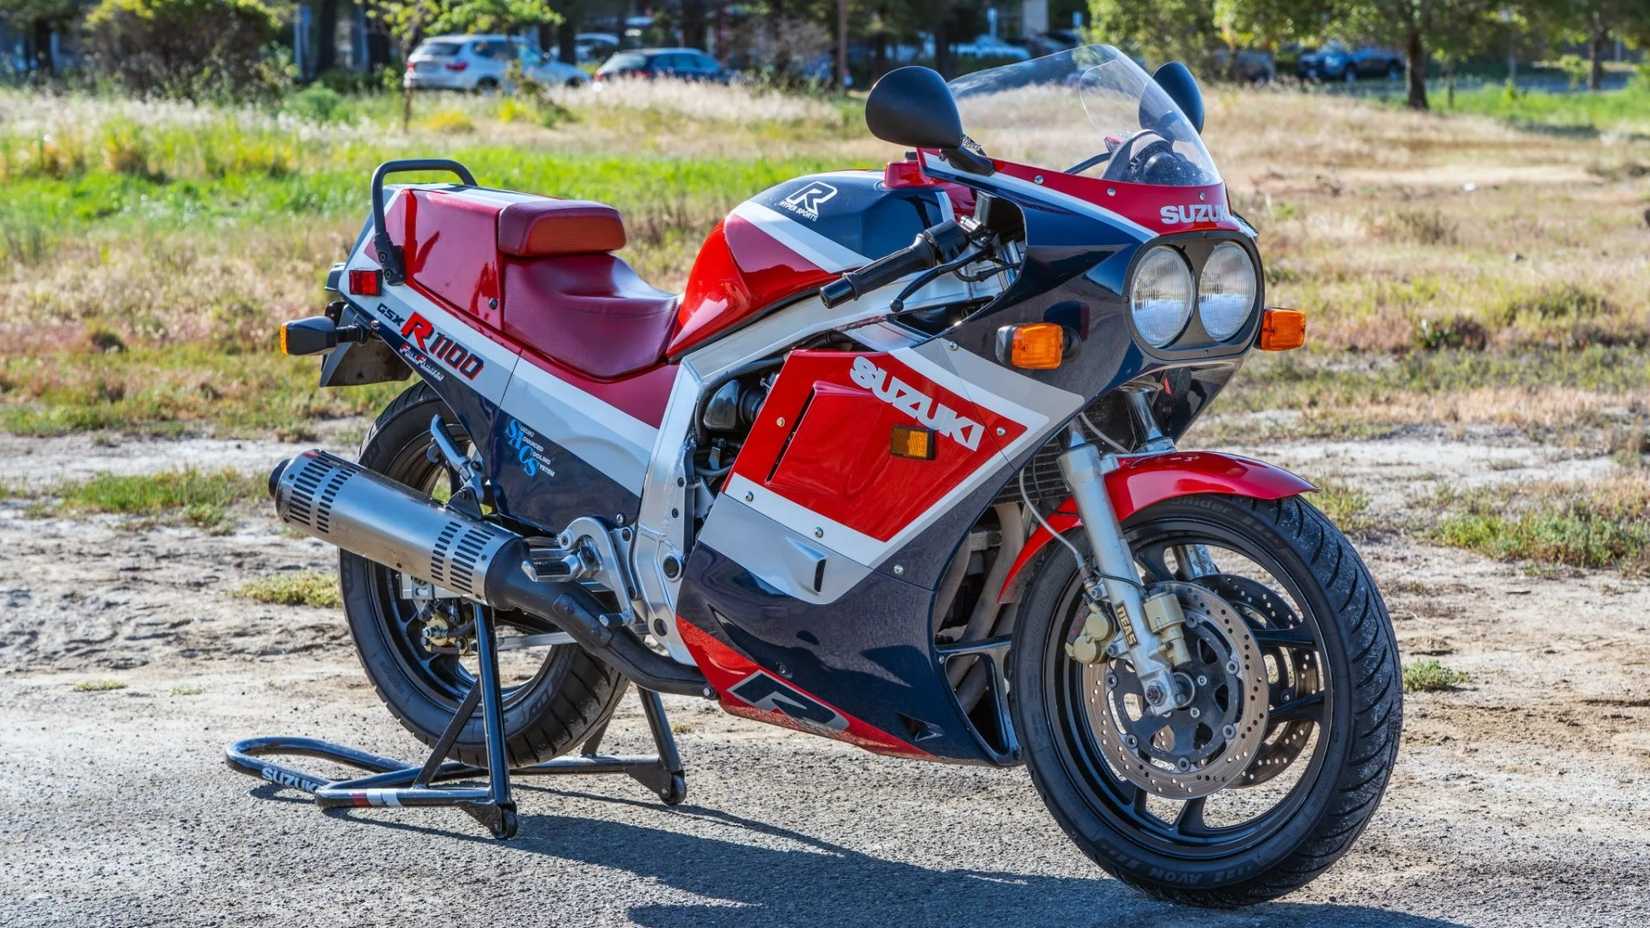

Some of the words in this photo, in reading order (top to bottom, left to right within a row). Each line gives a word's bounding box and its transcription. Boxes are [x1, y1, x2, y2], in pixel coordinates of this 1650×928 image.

[785, 181, 838, 217] R
[1160, 204, 1229, 225] SUZU
[850, 355, 985, 452] SUZUKI
[261, 767, 321, 793] SUZUK
